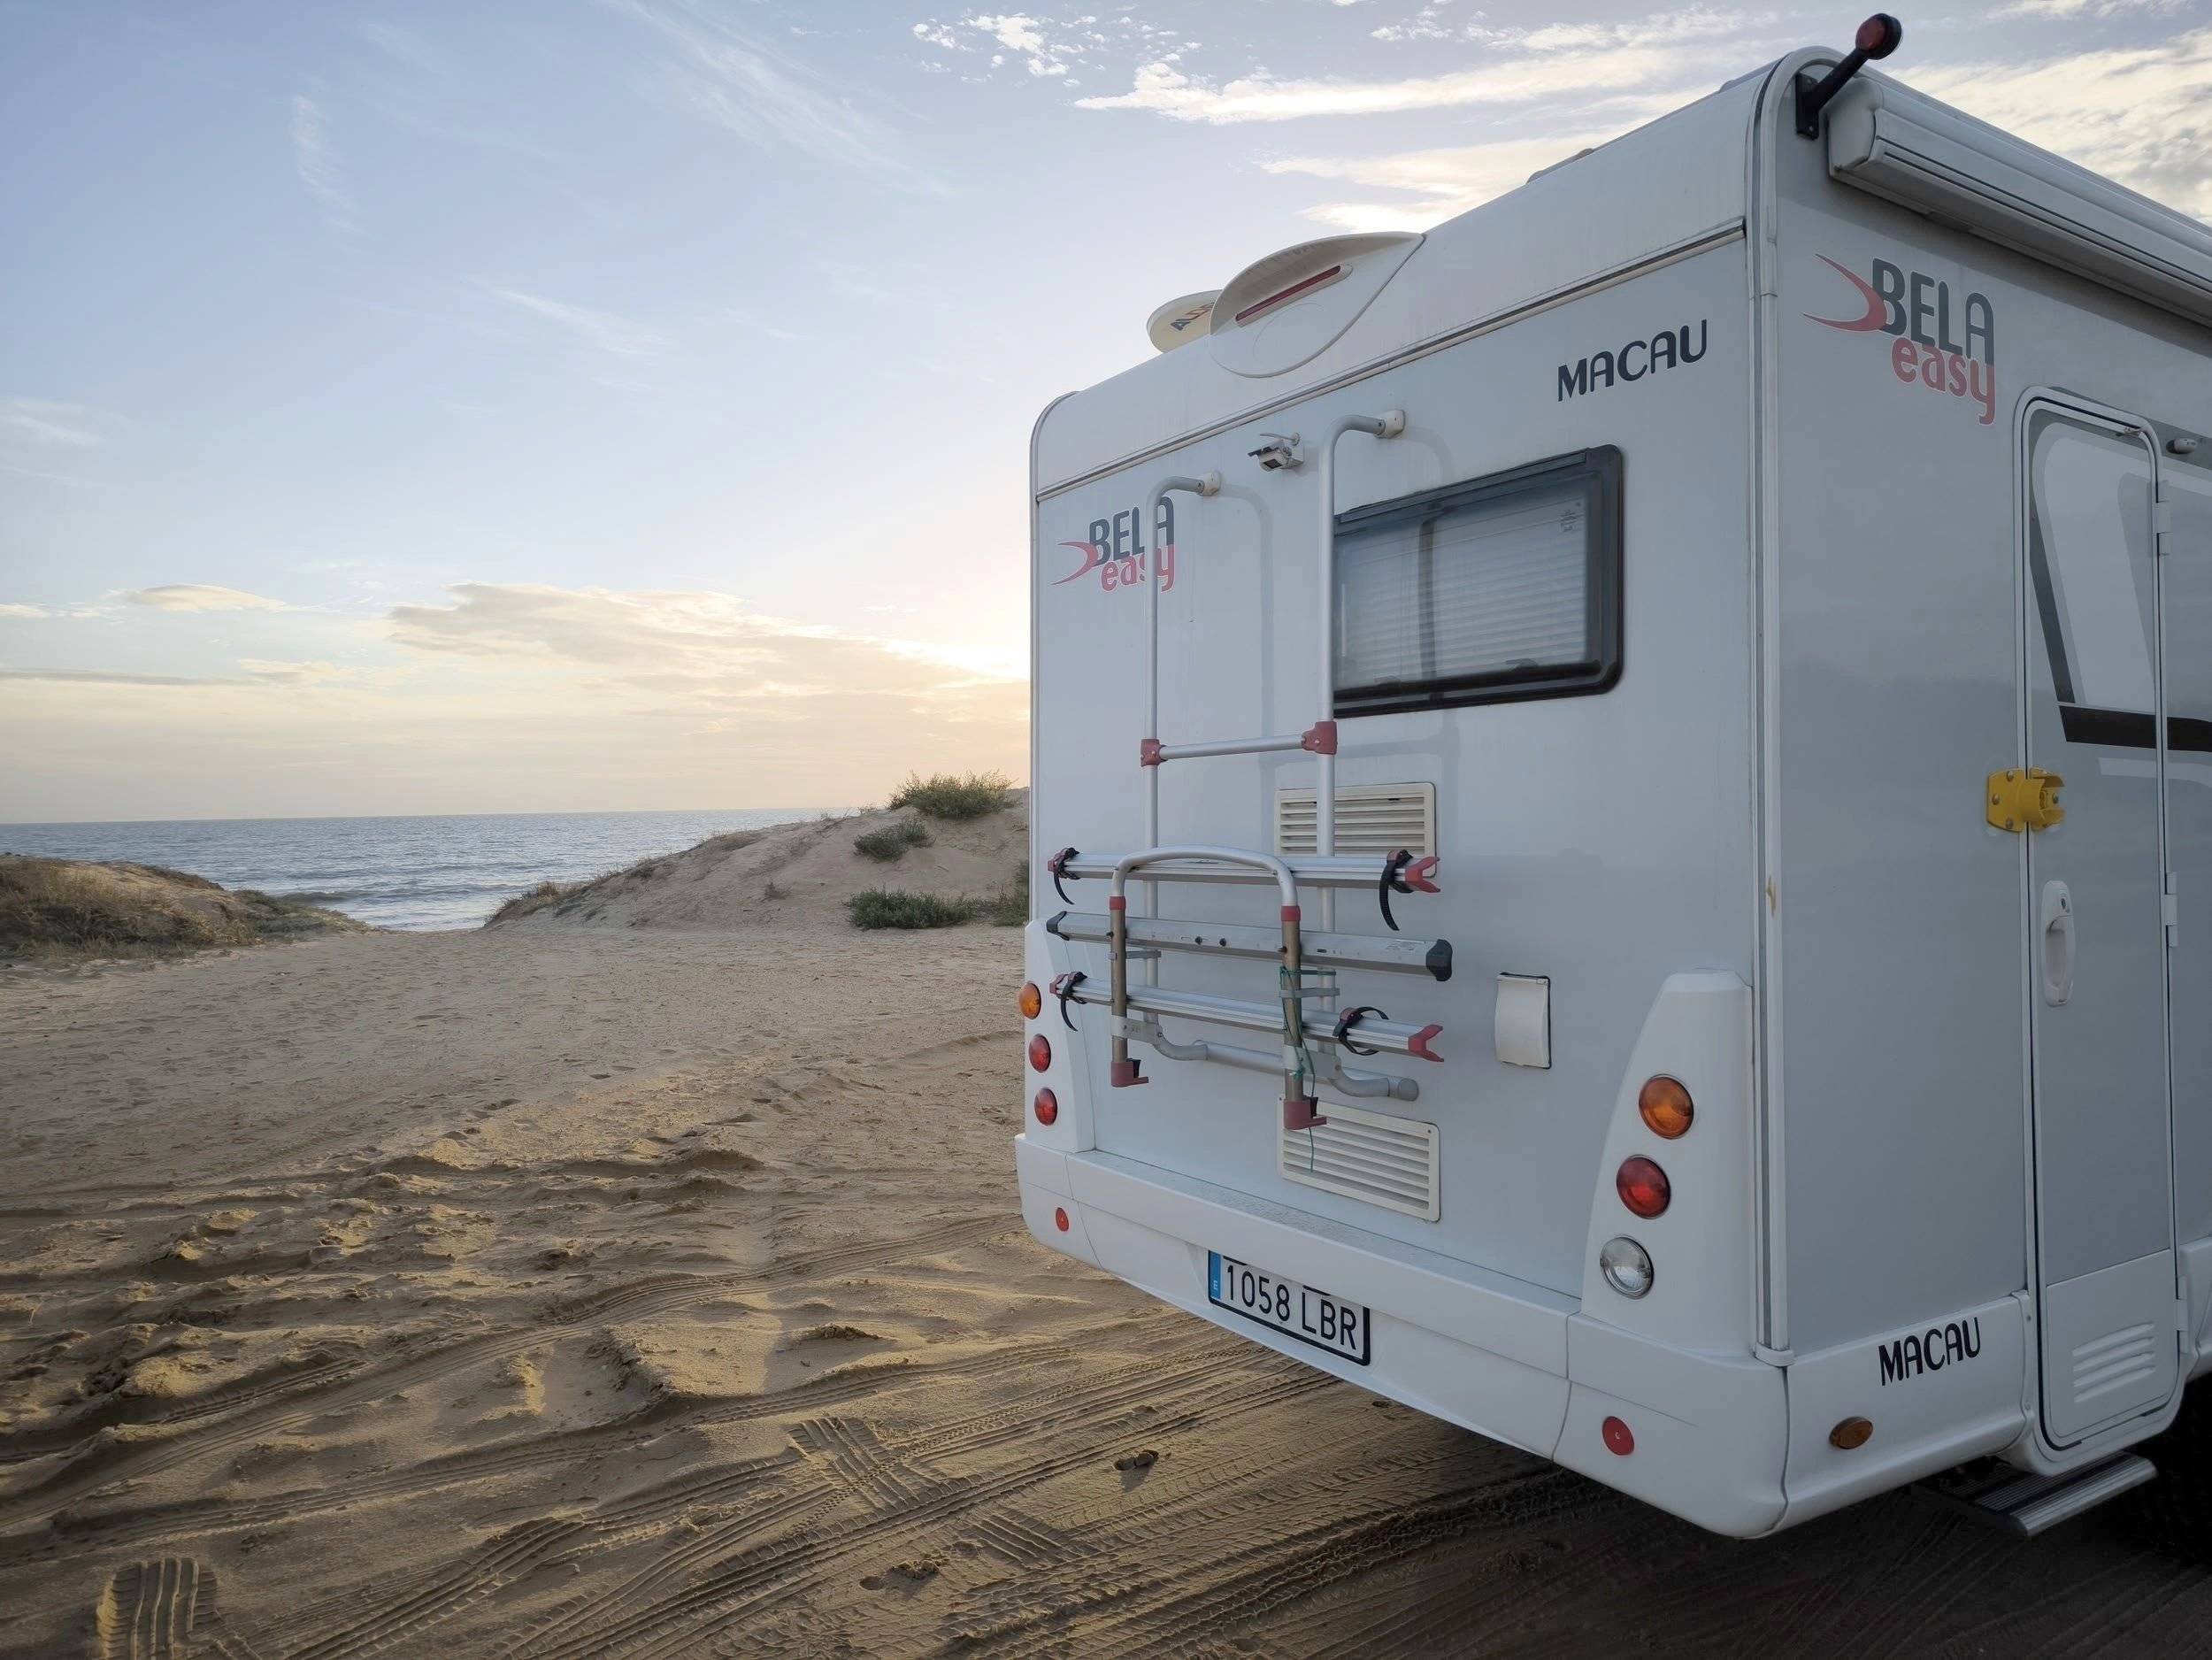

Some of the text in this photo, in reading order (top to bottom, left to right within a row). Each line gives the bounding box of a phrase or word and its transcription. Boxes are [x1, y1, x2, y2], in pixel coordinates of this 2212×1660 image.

[1872, 257, 1994, 365] BELA
[1558, 319, 1707, 402] MACAU
[1891, 337, 1995, 425] easy
[1089, 496, 1174, 566] BELA
[1227, 1264, 1357, 1350] 1058 LBR
[1878, 1317, 1981, 1387] MACAU
